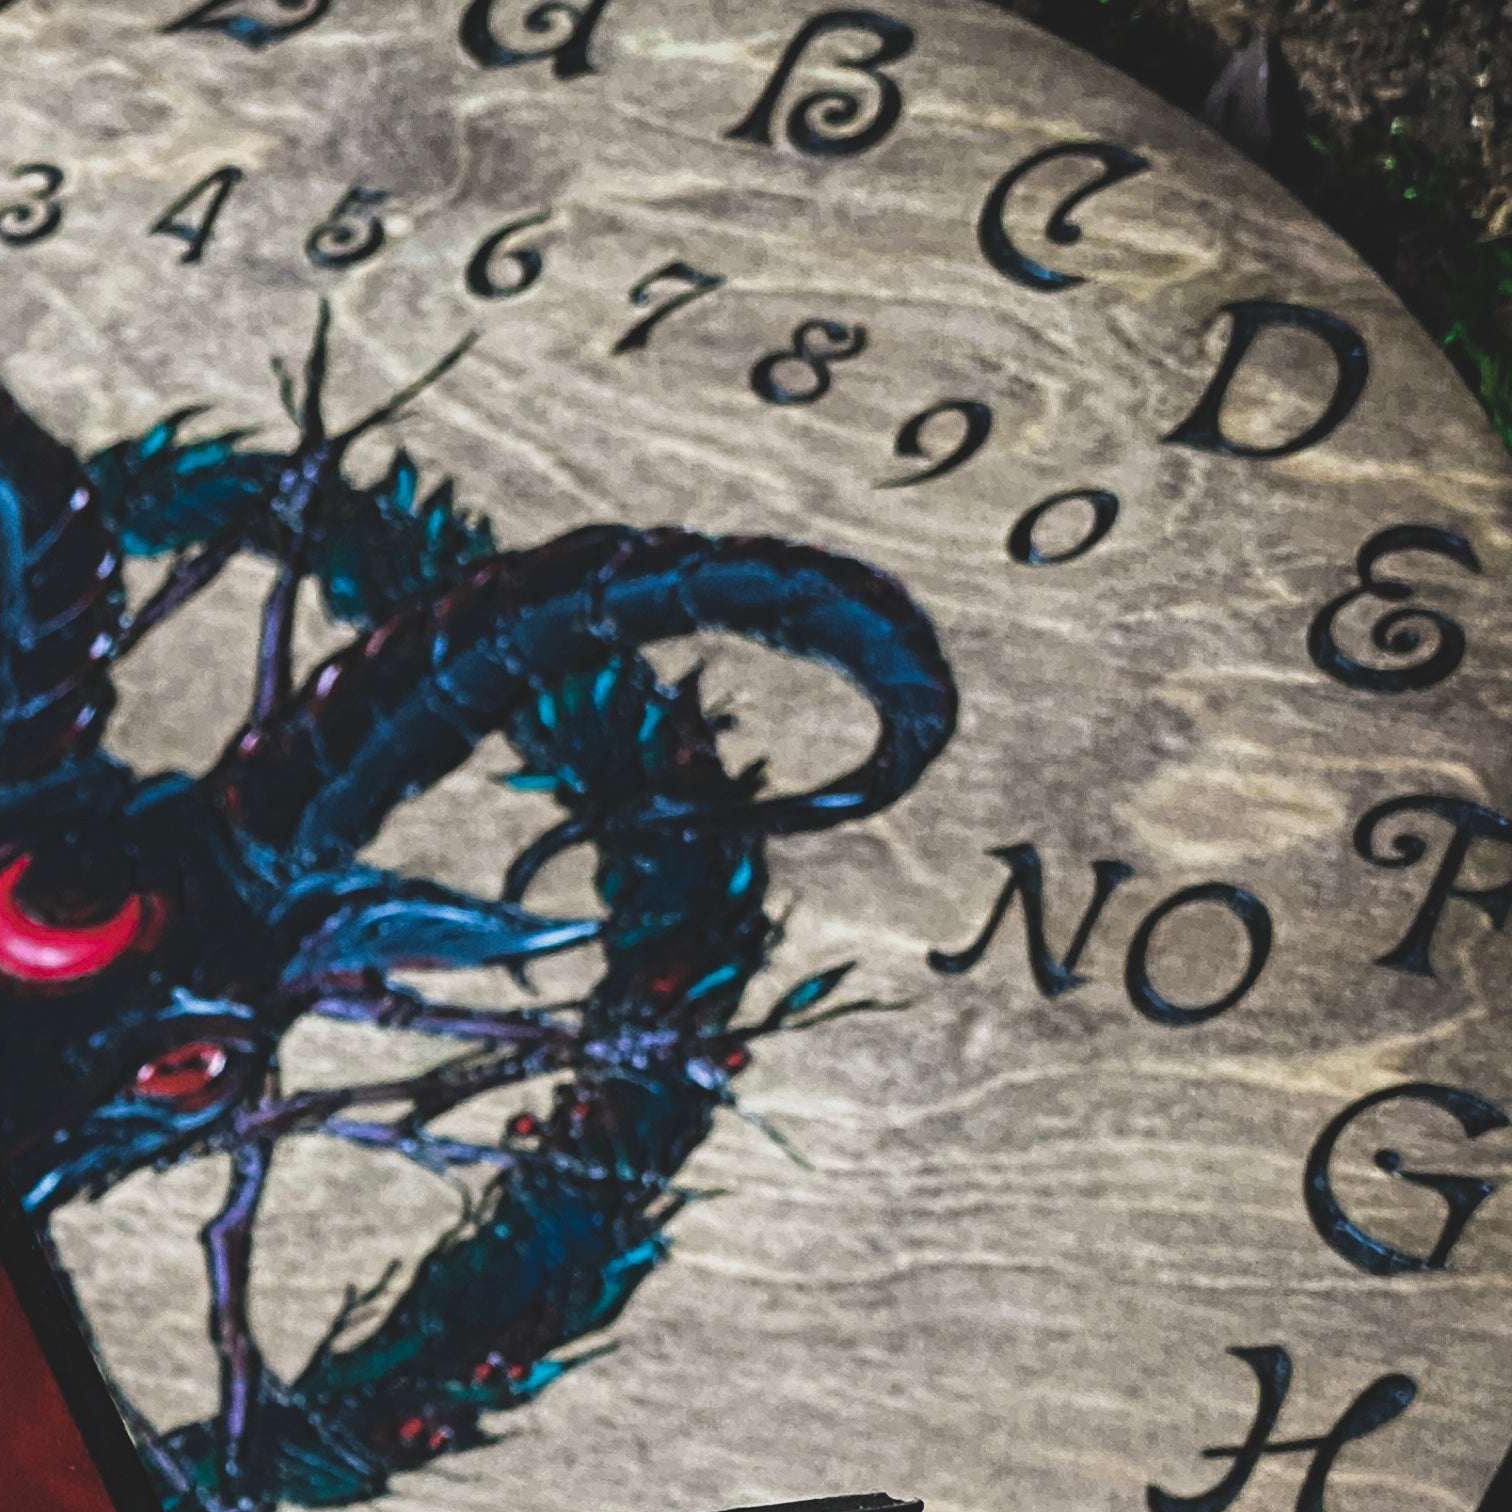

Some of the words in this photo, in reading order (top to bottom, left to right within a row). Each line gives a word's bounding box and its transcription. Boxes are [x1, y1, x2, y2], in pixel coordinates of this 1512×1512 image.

[723, 5, 920, 162] B
[976, 139, 1152, 292] C
[149, 164, 248, 266] 4
[306, 186, 390, 270] 5
[463, 208, 552, 300] 6
[611, 259, 725, 357] 7
[748, 318, 870, 407] 8
[876, 400, 994, 489] 9
[1160, 299, 1370, 461] D
[1306, 522, 1487, 698] E
[926, 840, 1275, 1029] NO
[1351, 790, 1512, 987] F
[1302, 1079, 1512, 1279] G
